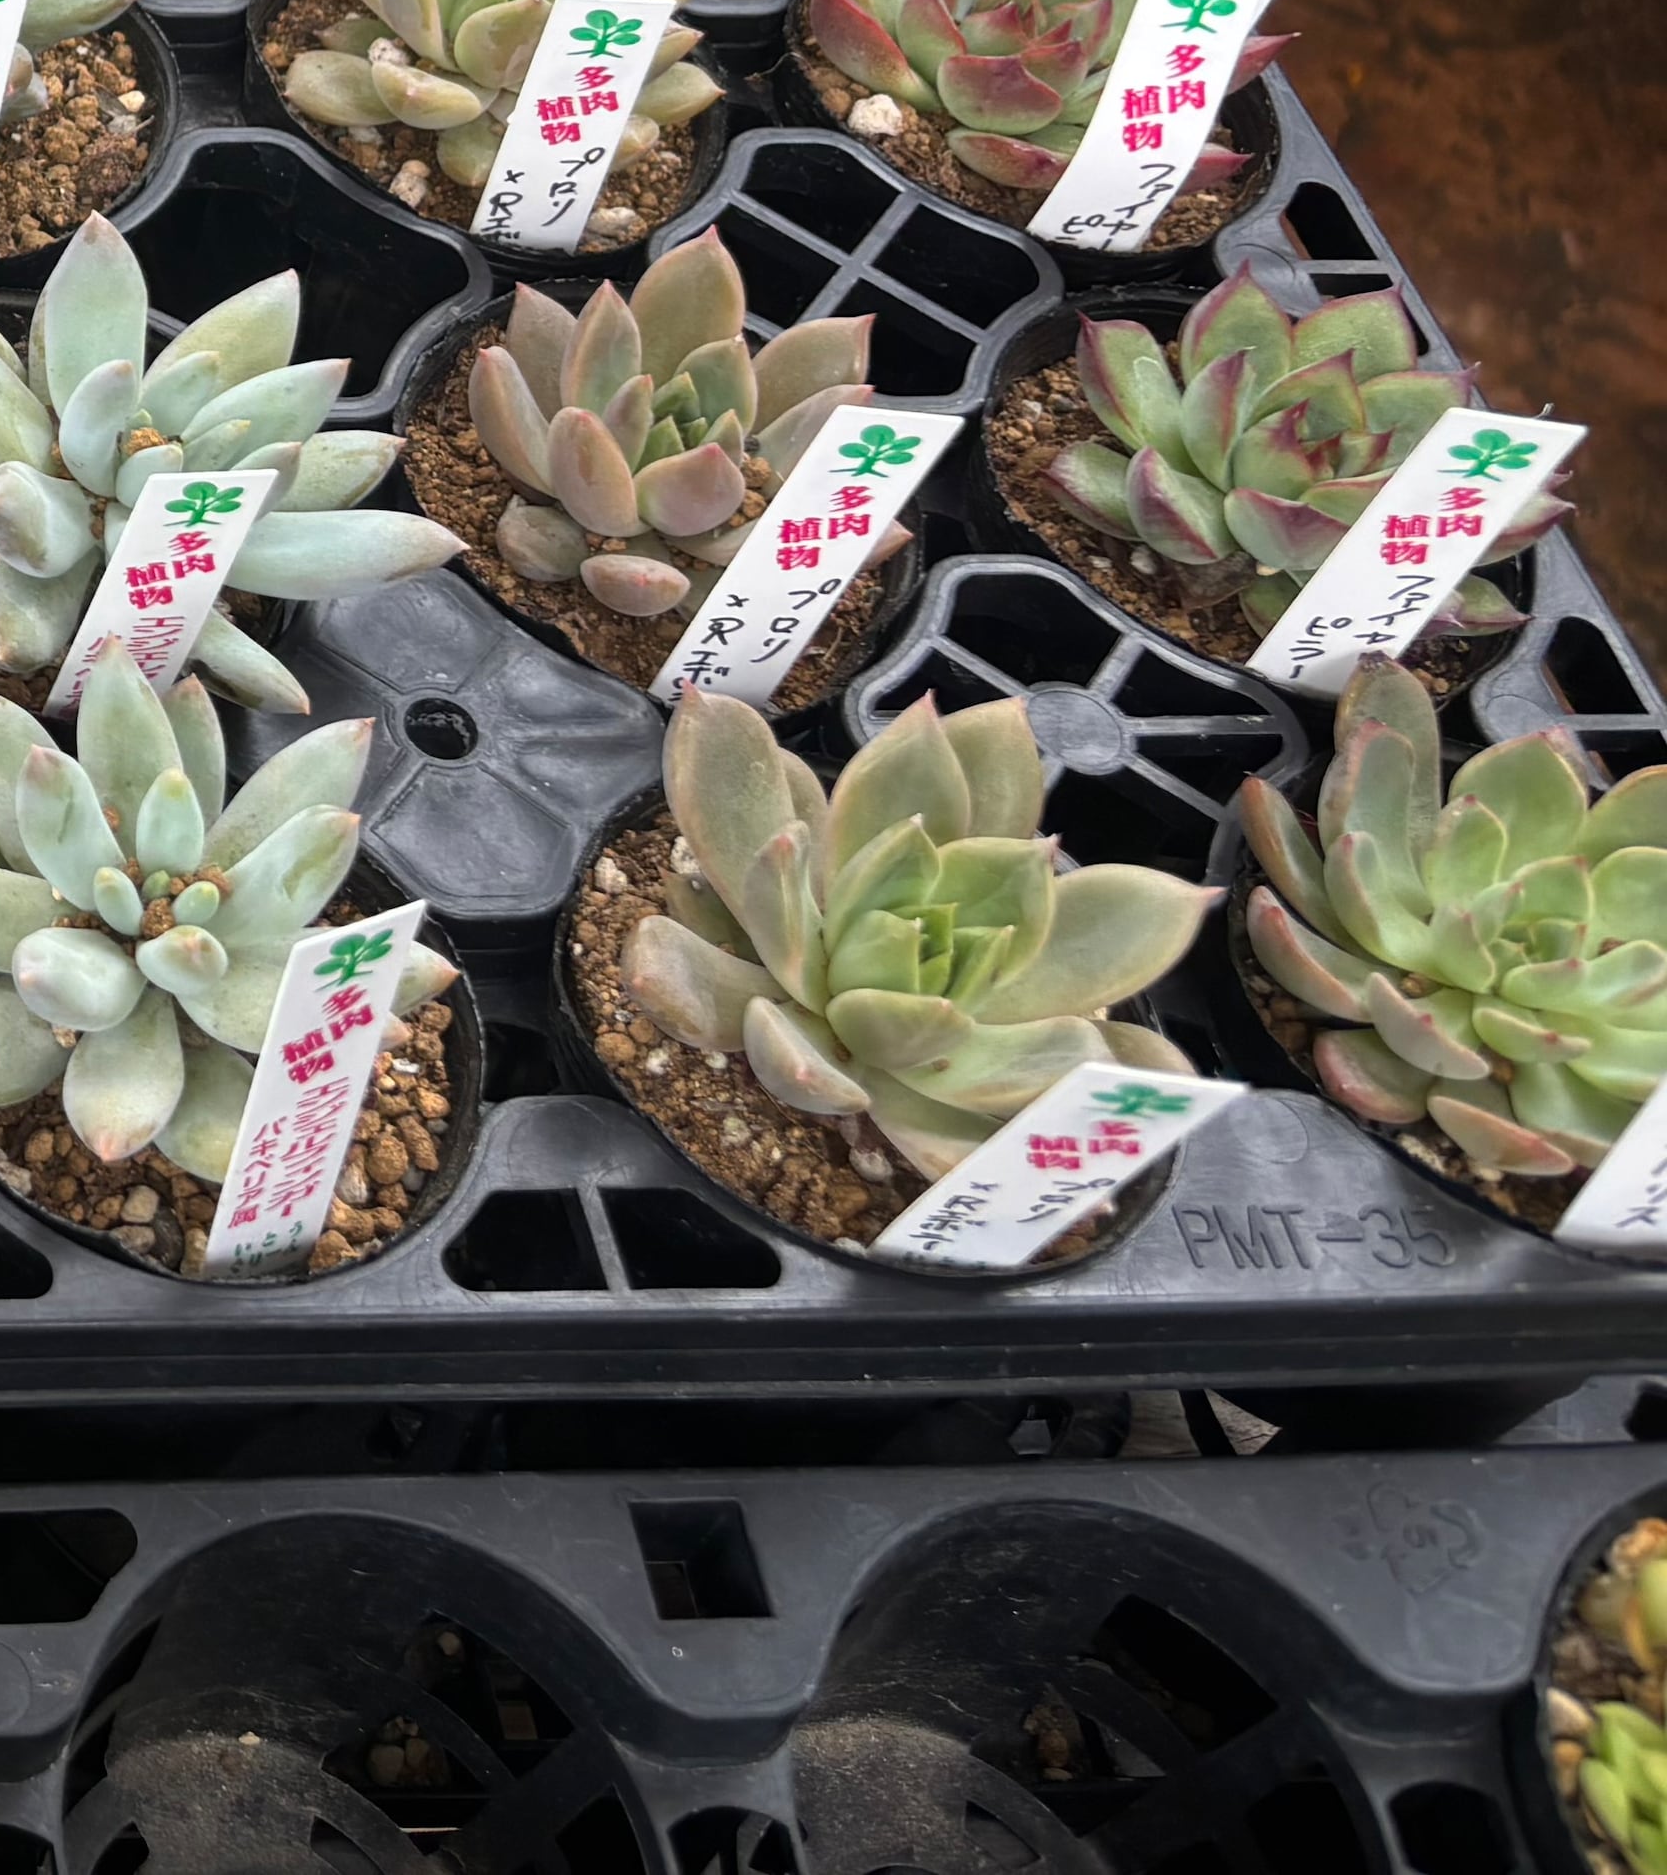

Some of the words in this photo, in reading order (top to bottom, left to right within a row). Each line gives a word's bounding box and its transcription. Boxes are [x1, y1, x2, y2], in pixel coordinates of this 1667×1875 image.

[538, 67, 619, 145] 多肉植物
[1121, 44, 1206, 153] 多肉植物
[777, 487, 871, 571] 多肉植物
[1382, 488, 1484, 565] 多肉植物
[127, 532, 216, 610] 多肉植物
[281, 984, 375, 1084] 多肉植物
[228, 1116, 288, 1229] パキベリア属
[1171, 1203, 1457, 1270] PMT-35
